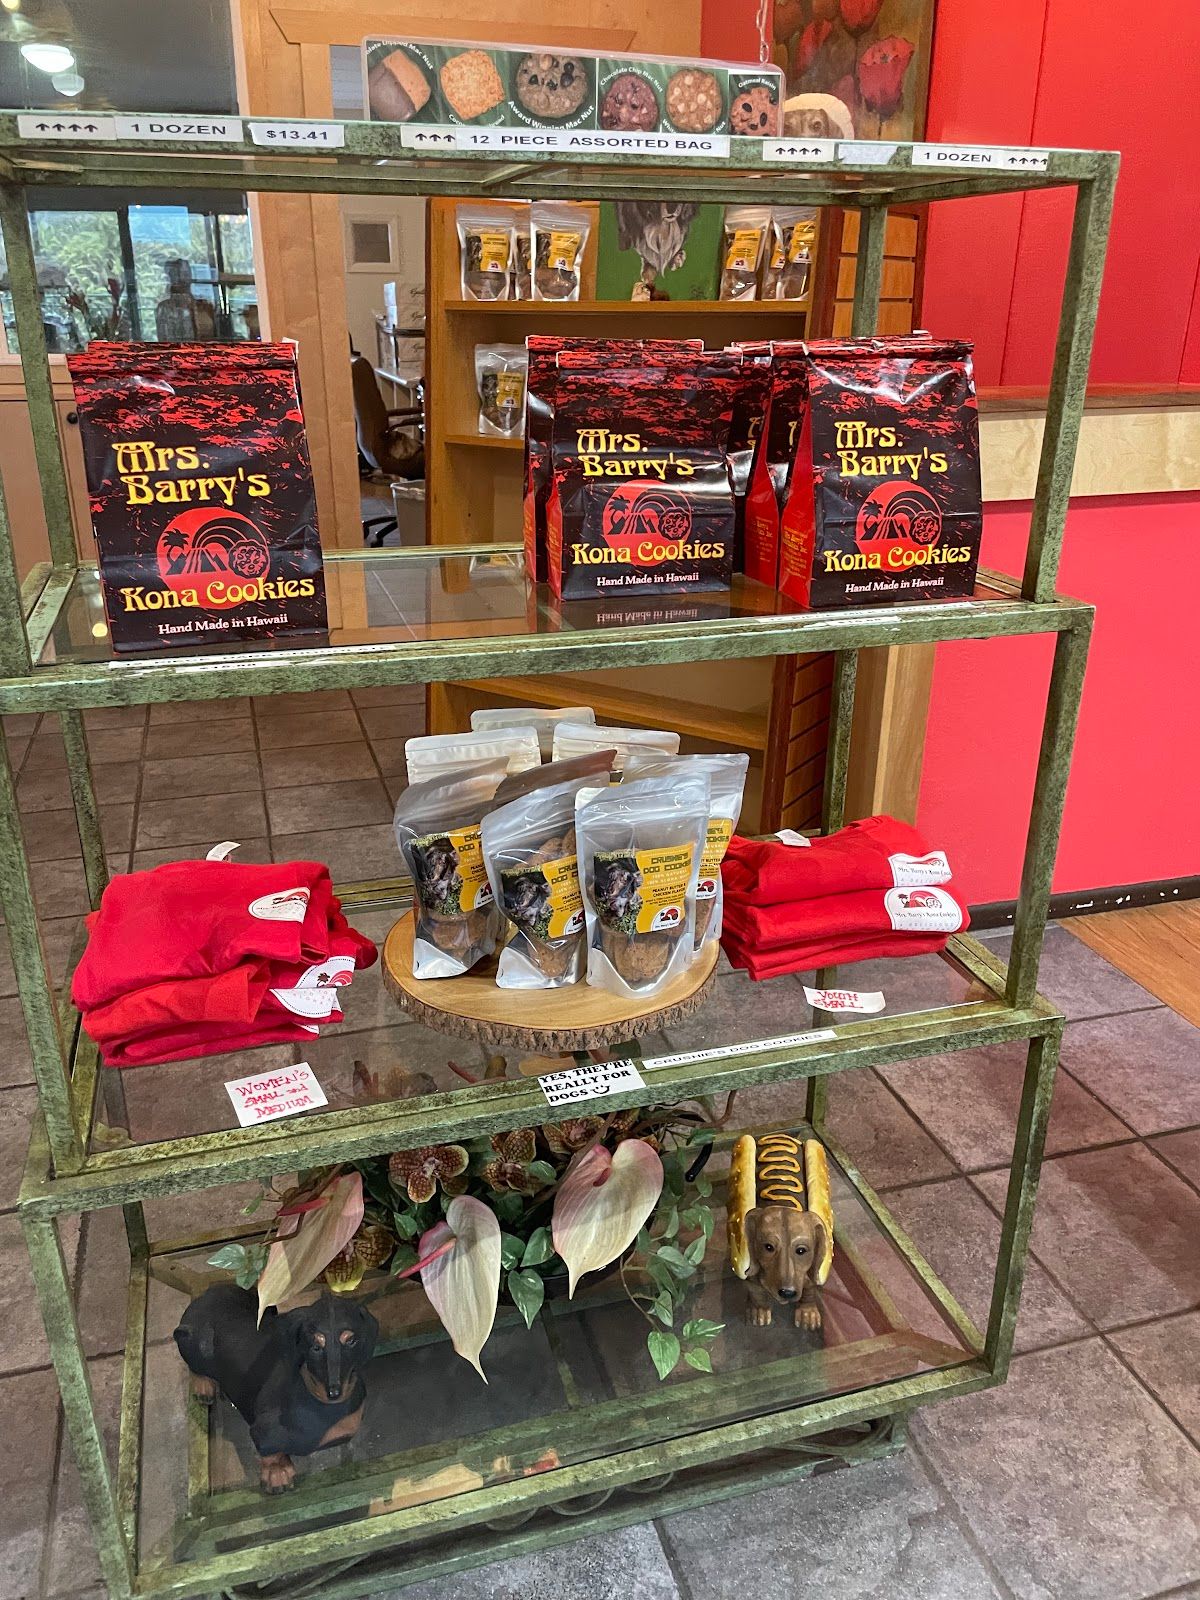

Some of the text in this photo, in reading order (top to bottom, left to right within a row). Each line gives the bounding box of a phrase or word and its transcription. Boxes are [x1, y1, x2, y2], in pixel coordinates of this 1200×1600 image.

[408, 44, 422, 56] Mac
[422, 54, 434, 70] Nut
[600, 67, 628, 85] Chocolate
[508, 100, 532, 124] Award
[566, 118, 582, 130] Mac
[580, 105, 594, 120] Nut
[131, 124, 226, 135] 1 DOZEN
[266, 129, 329, 141] $13.41
[470, 135, 712, 150] 12 PIECE ASSORTED BAG
[924, 152, 992, 164] 1 DOZEN
[576, 428, 648, 453] Mrs.
[834, 421, 903, 450] Mrs.
[112, 441, 210, 474] Mrs.
[578, 452, 695, 480] Barry's
[837, 447, 948, 480] Barry's
[120, 467, 271, 506] Barry's
[571, 543, 632, 566] Kona
[638, 540, 725, 562] Cookies
[823, 549, 882, 573] Kona
[888, 544, 972, 568] Cookies
[596, 572, 700, 587] Hand Made in Hawaii
[845, 576, 944, 593] Hand Made in Hawaii
[120, 576, 315, 612] Kona Cookies
[158, 613, 288, 634] Hand Made in Hawaii
[643, 866, 660, 874] DOG
[816, 991, 858, 1001] YOUTH
[653, 1032, 823, 1065] CRUSHIE'S DOG COOKIES
[539, 1059, 632, 1084] YES, THEY'RE
[544, 1070, 632, 1093] REALLY FOR
[254, 1095, 314, 1119] MEDIUM
[548, 1088, 588, 1102] DOGS
